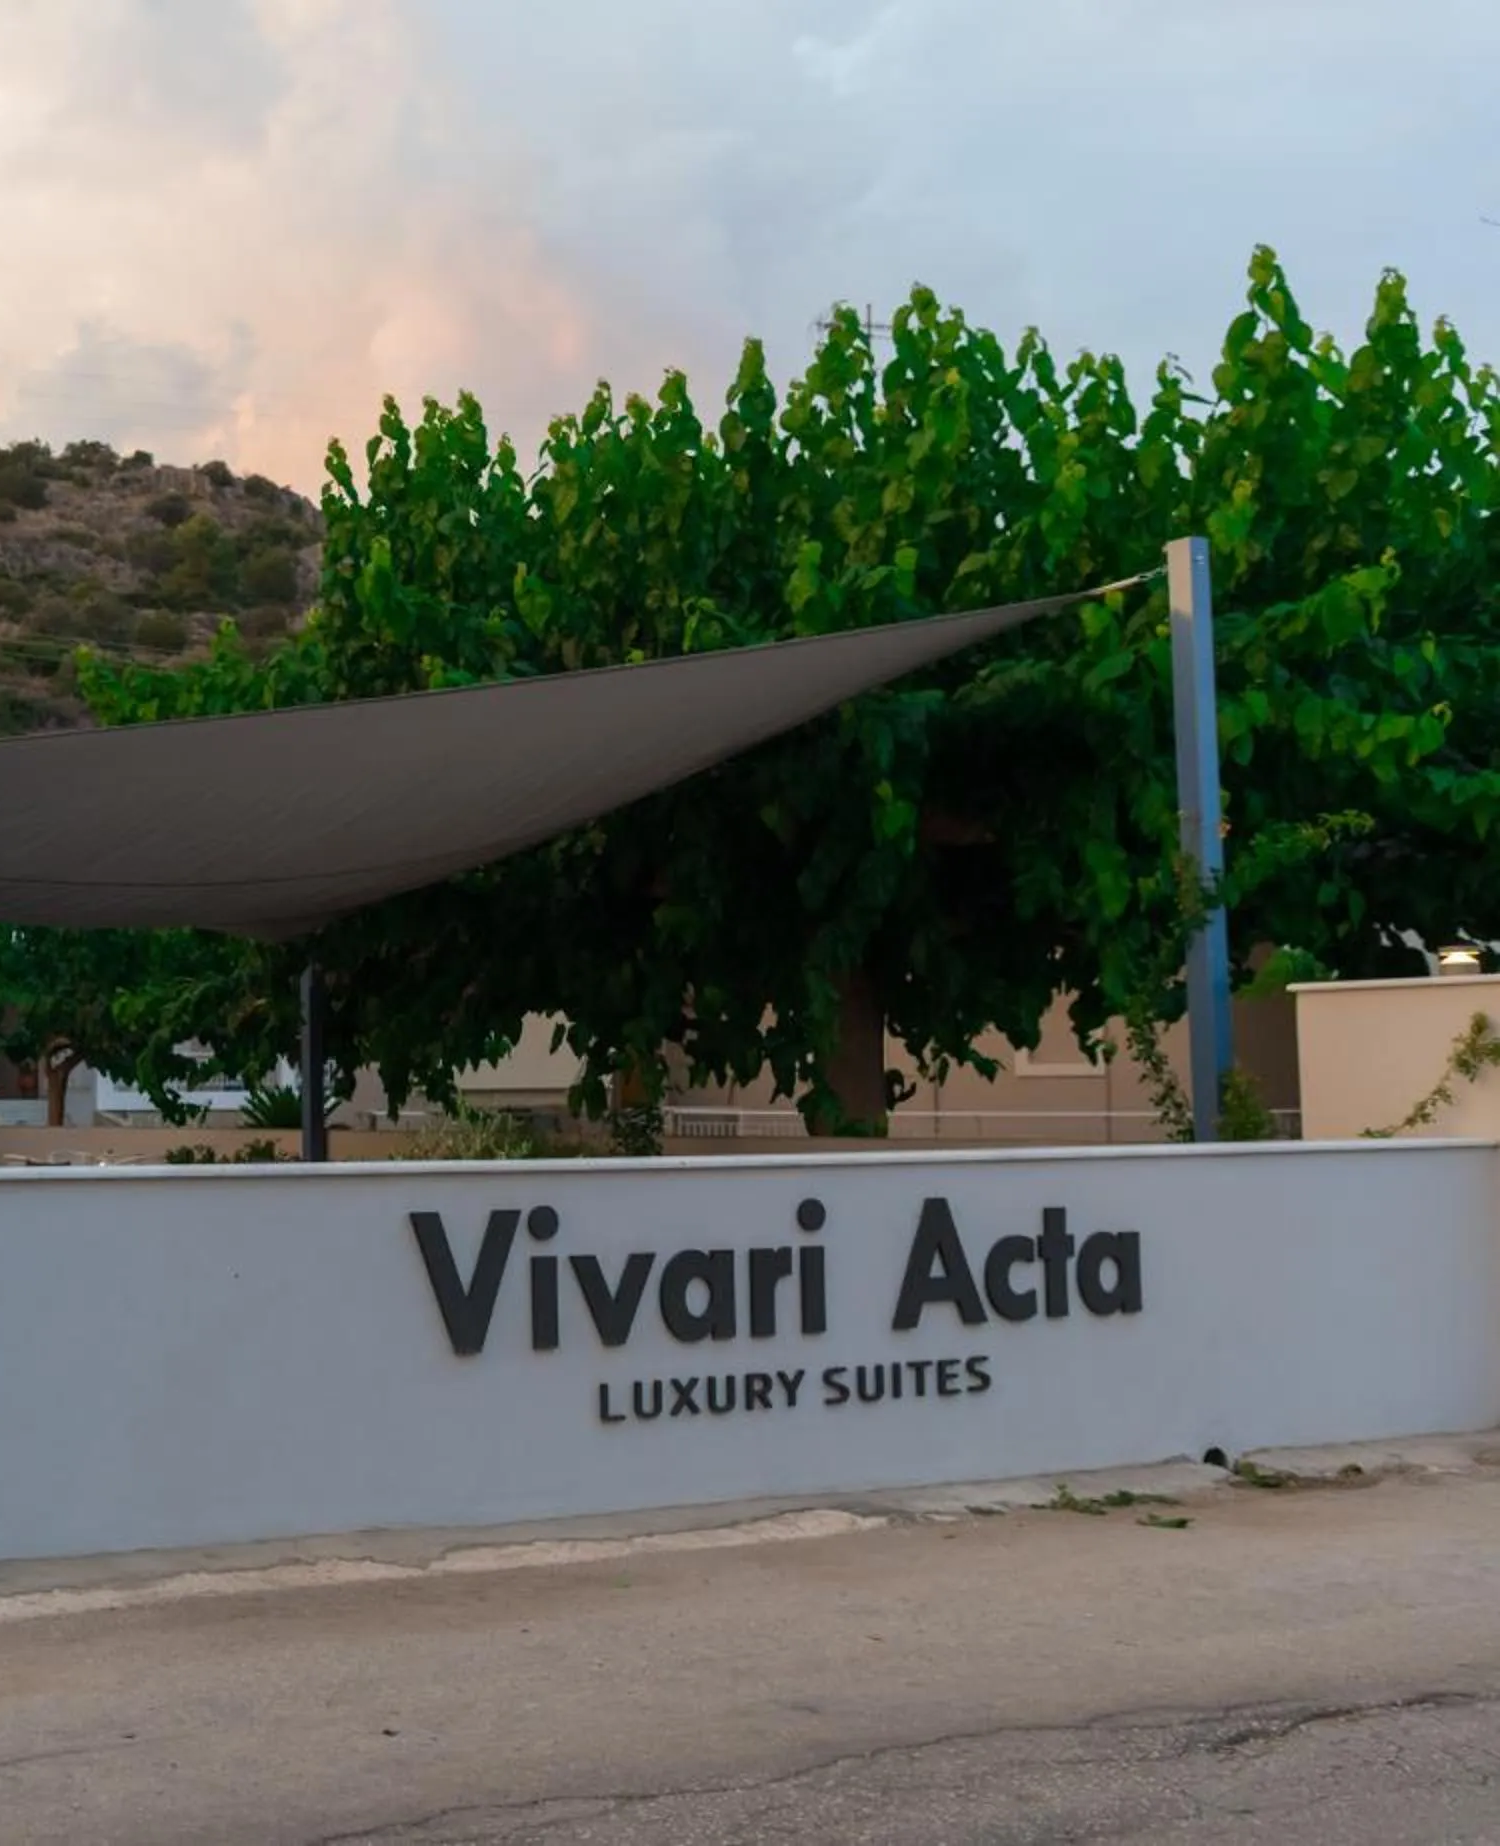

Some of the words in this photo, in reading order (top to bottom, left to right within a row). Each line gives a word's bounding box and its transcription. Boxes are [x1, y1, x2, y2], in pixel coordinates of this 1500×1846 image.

[408, 1197, 828, 1358] Vivari
[891, 1197, 1143, 1332] Acta
[598, 1369, 806, 1424] LUXURY
[821, 1355, 992, 1407] SUITES
